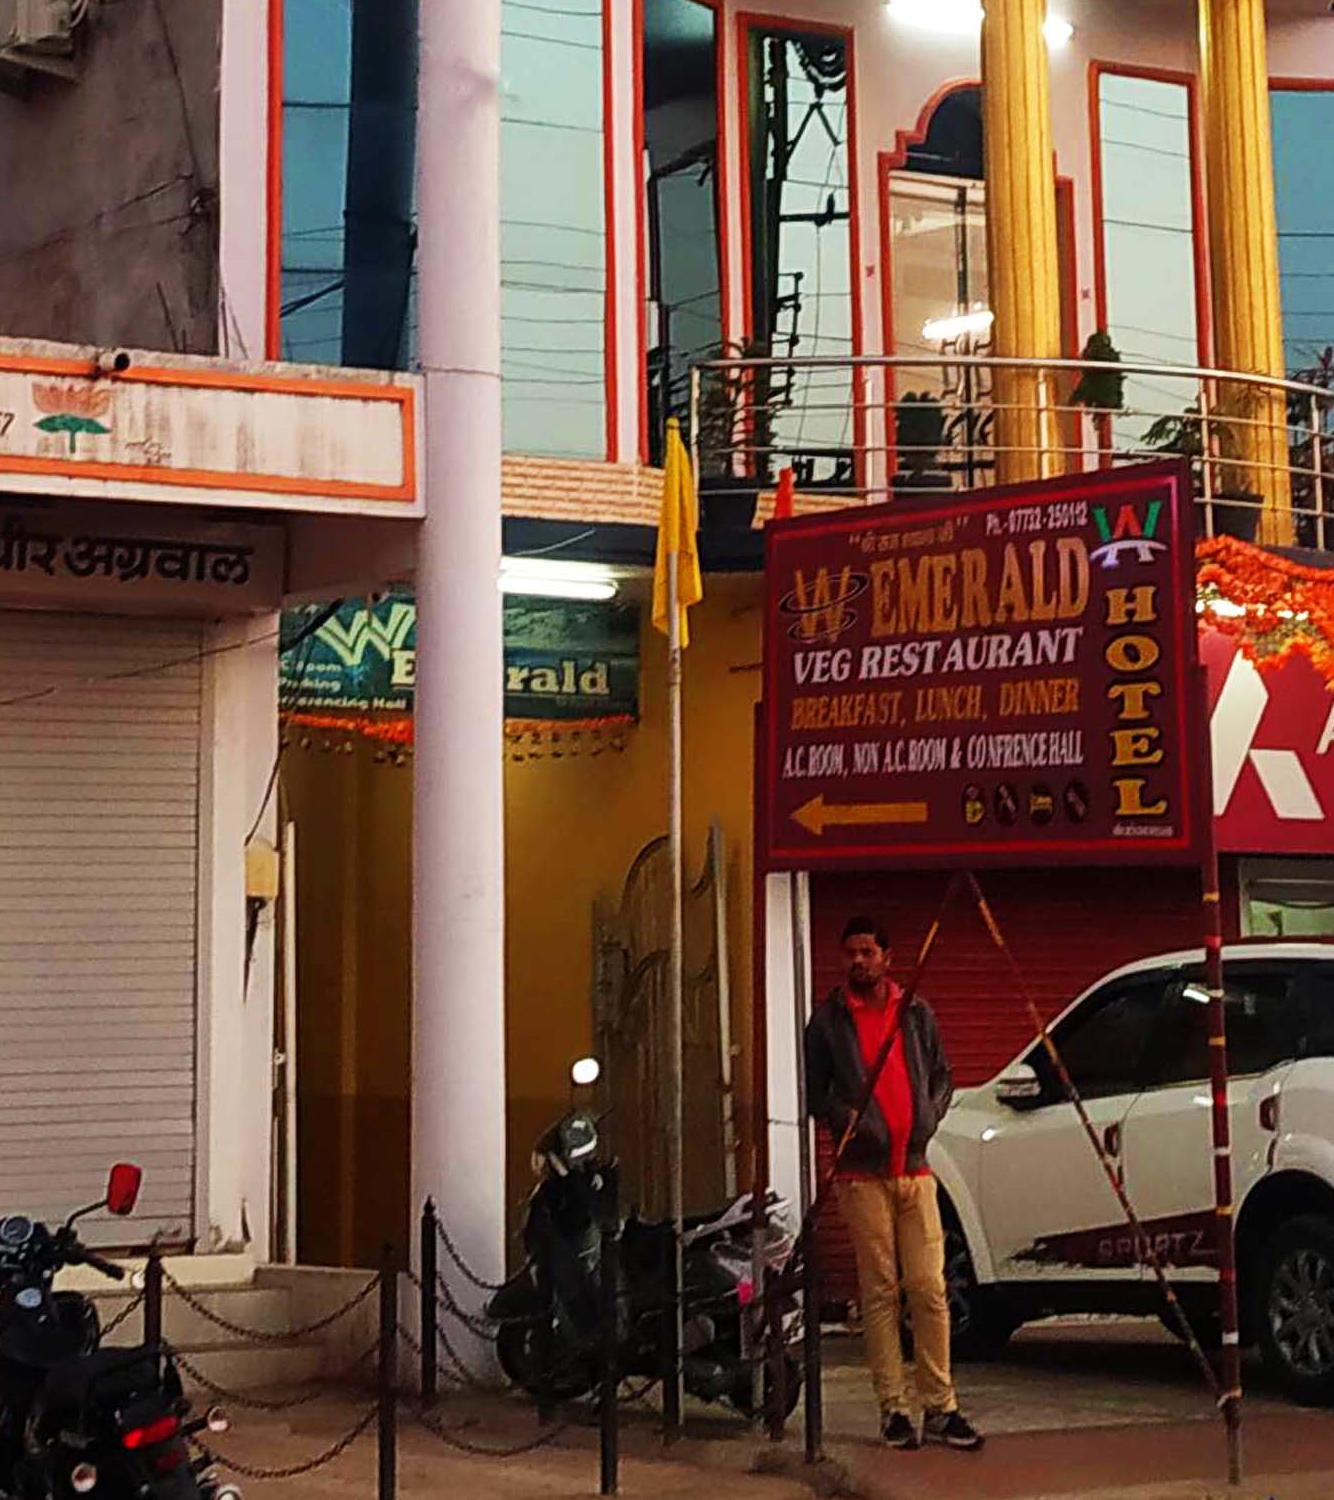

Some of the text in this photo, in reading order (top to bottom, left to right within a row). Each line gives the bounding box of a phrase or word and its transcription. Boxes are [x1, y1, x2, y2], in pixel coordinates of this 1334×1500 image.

[869, 536, 1091, 639] EMERALD
[793, 649, 852, 684] VEG
[999, 678, 1080, 717] DINNER
[1105, 585, 1168, 817] HOTEL
